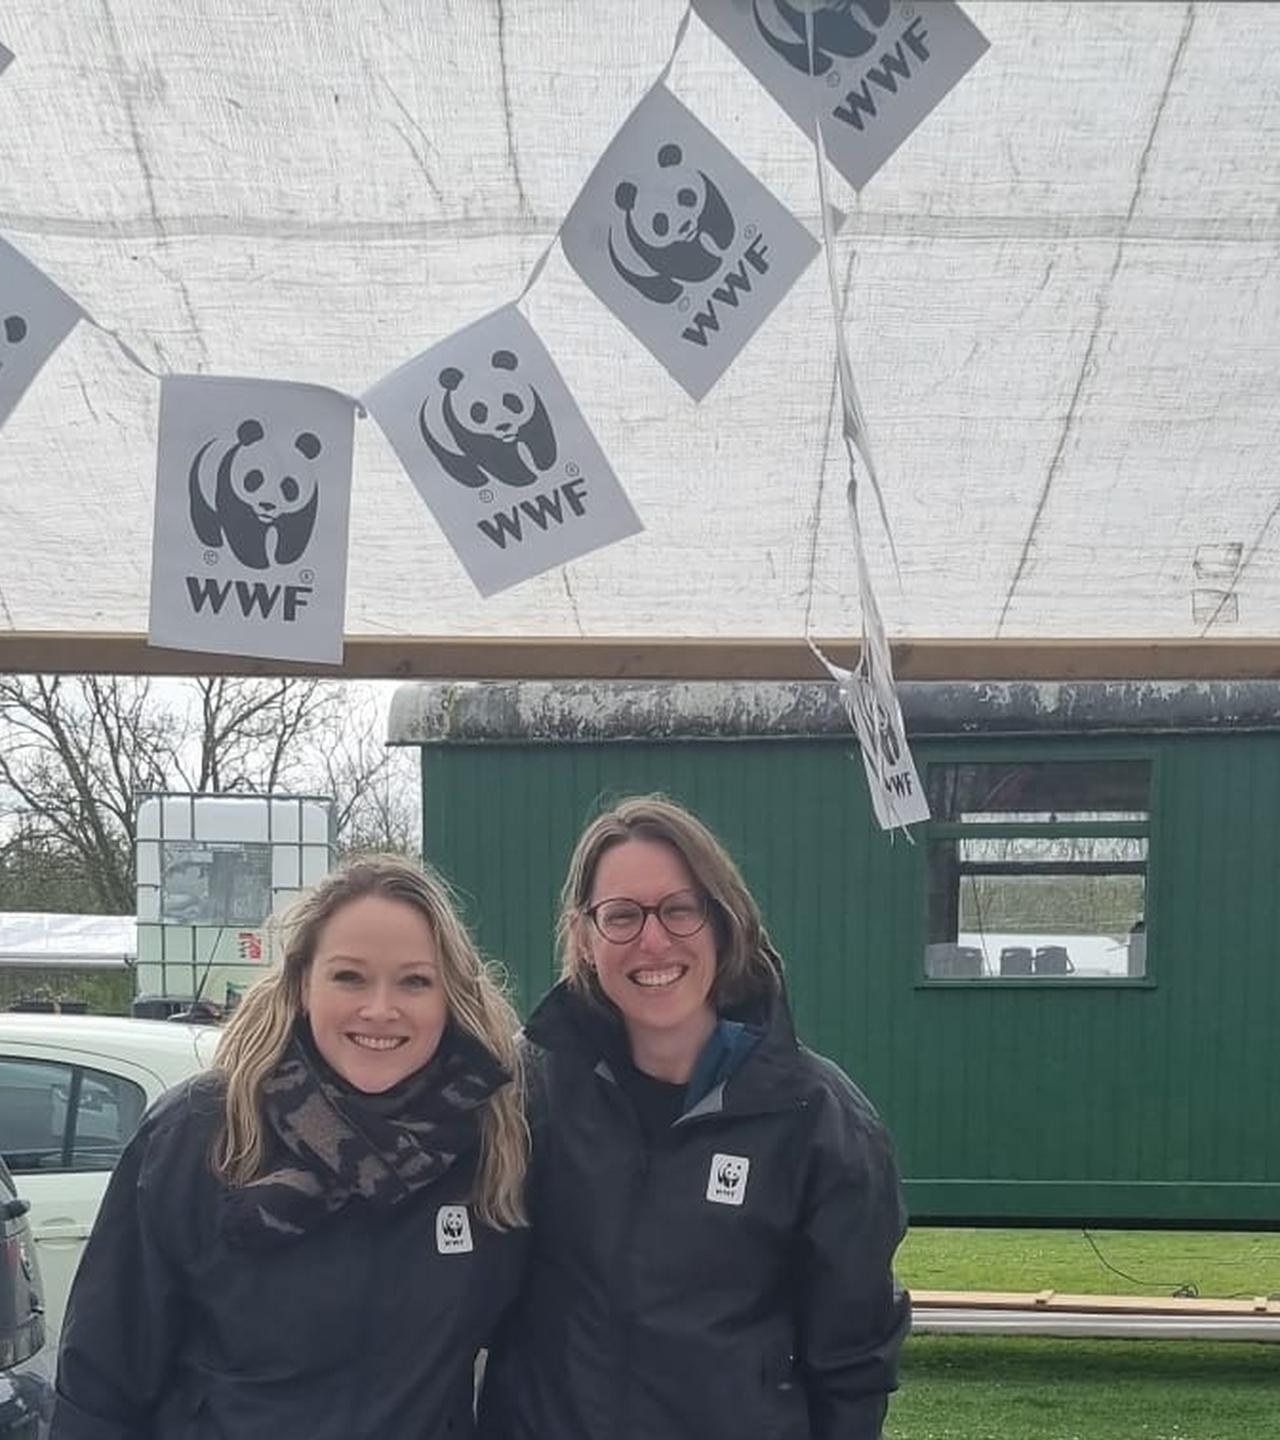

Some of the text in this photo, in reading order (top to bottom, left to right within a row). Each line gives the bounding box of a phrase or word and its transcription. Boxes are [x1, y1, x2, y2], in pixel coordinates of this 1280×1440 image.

[832, 18, 930, 132] WWF
[680, 233, 773, 349] WWF
[476, 477, 588, 551] WWF
[185, 576, 314, 622] WWF
